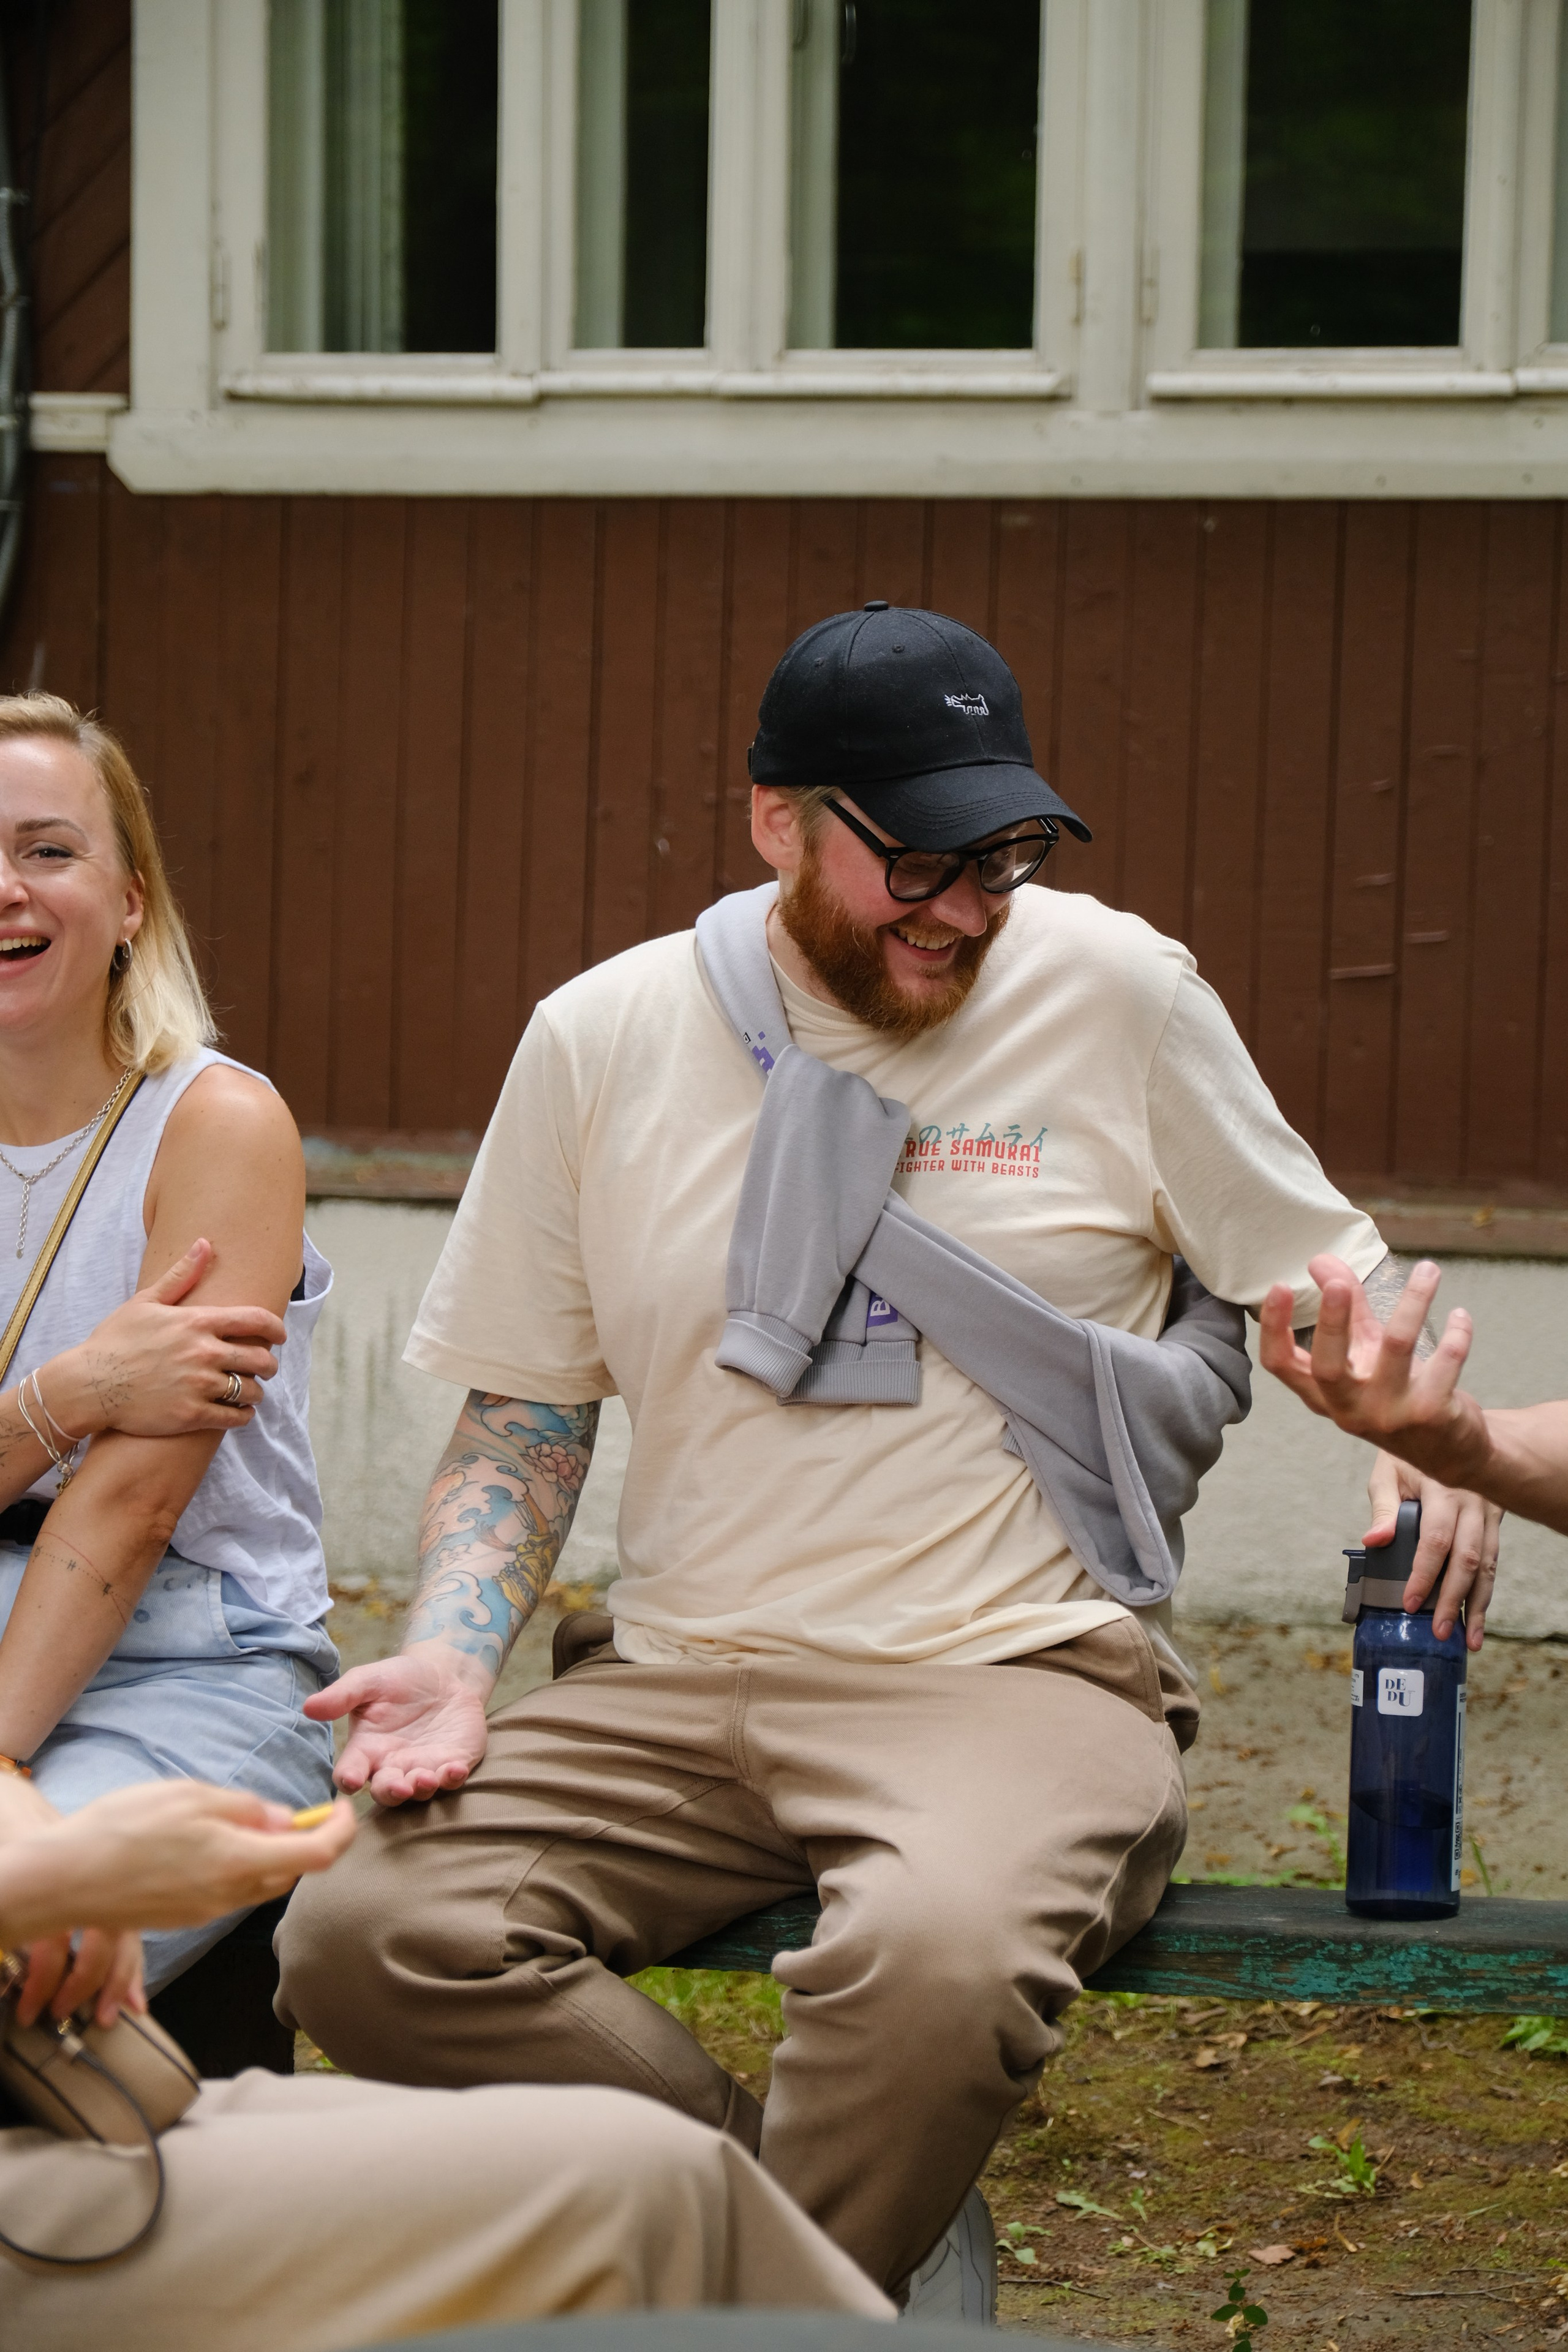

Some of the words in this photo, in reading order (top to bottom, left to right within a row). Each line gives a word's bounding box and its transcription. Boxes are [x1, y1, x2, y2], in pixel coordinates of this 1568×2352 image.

[905, 1123, 1048, 1152] のサムライ
[903, 1140, 942, 1158] RUE
[950, 1139, 1039, 1163] SAMURAI
[951, 1159, 985, 1172] WITH
[992, 1163, 1039, 1178] BEASTS
[1385, 1678, 1406, 1691] DE
[1387, 1691, 1415, 1707] DU
